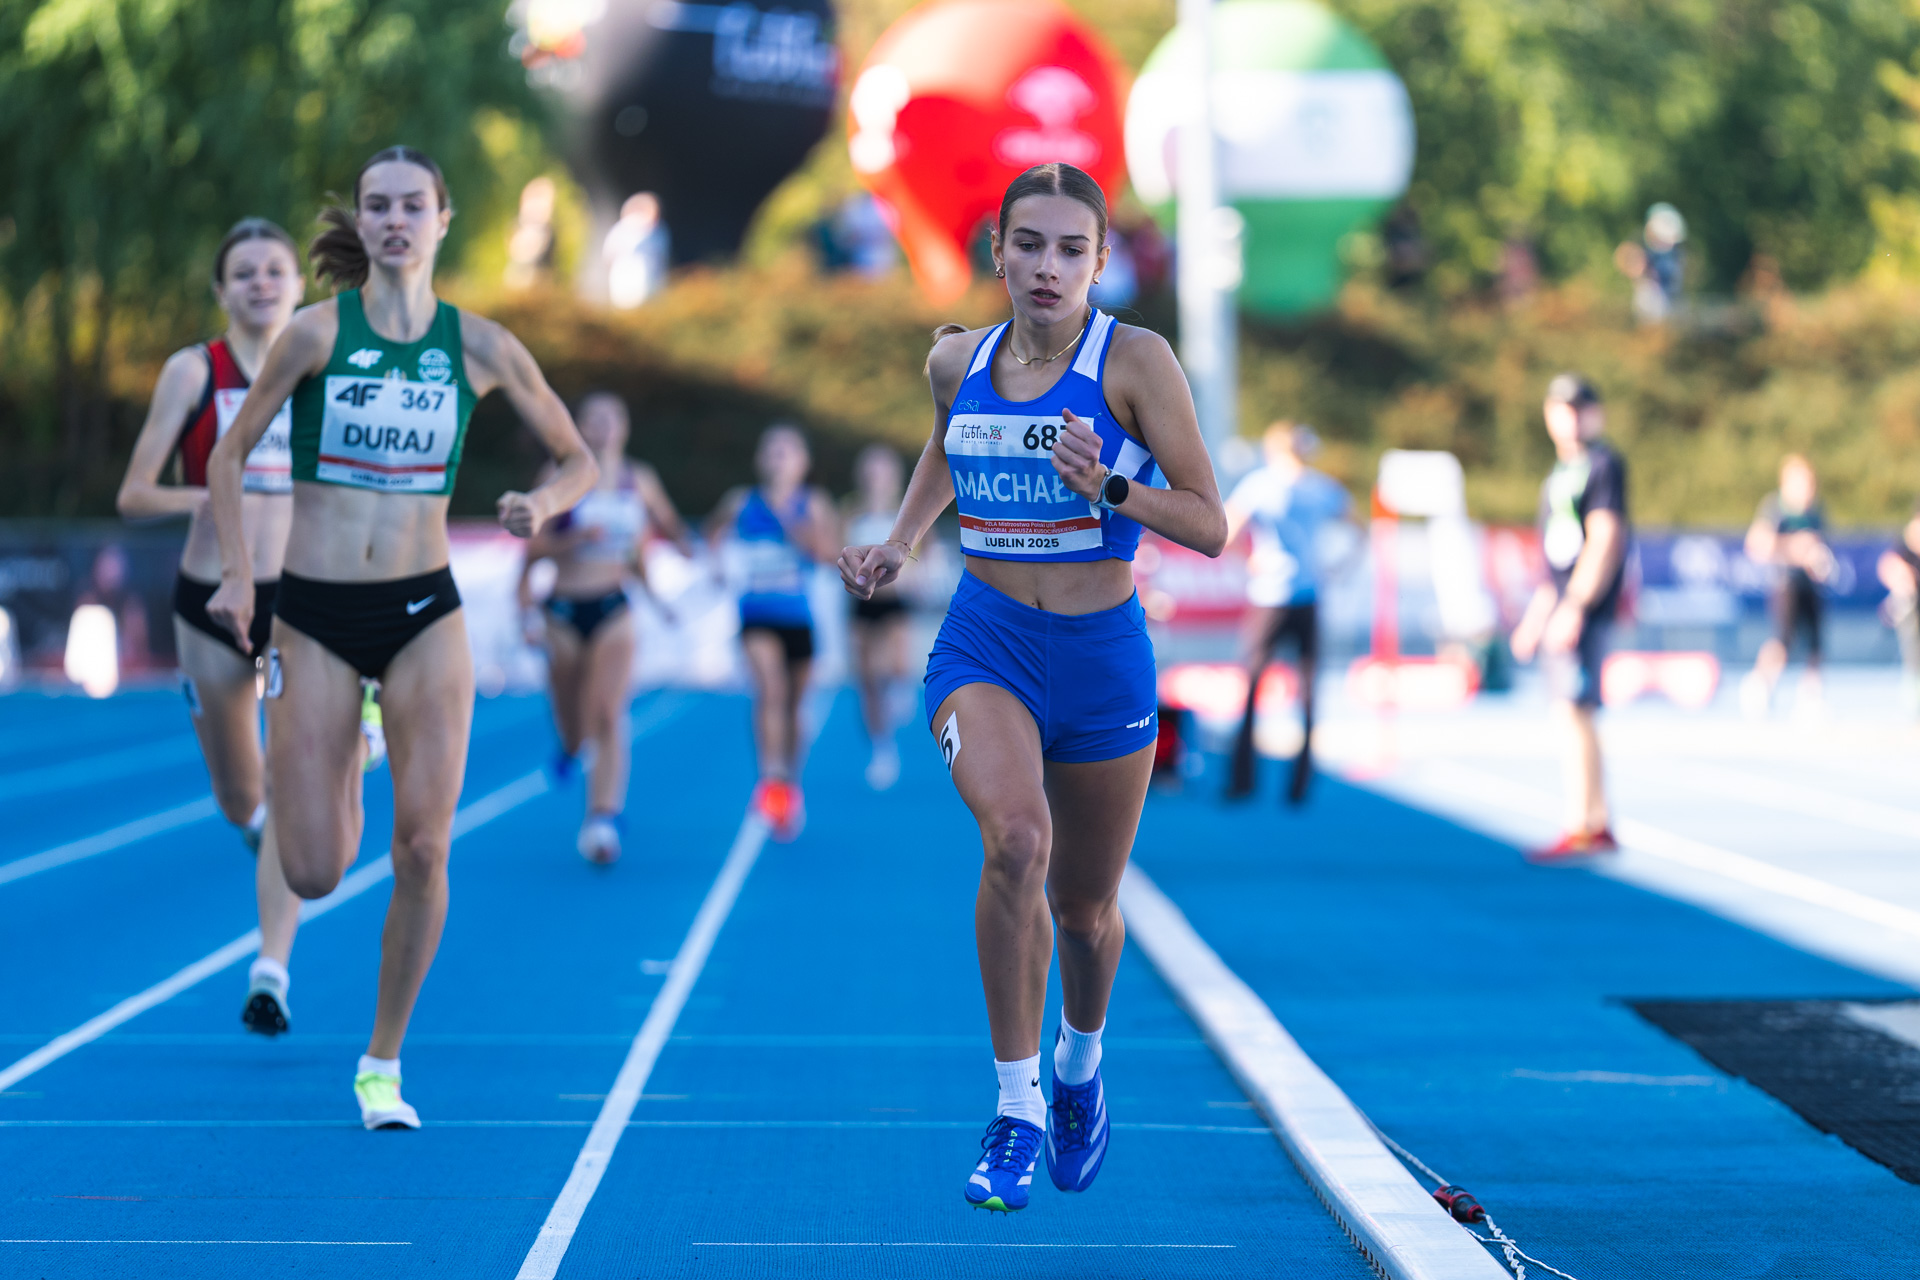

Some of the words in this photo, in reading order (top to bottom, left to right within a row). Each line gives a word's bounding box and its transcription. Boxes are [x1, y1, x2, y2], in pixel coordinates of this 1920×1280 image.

[336, 383, 384, 407] 4F
[401, 388, 445, 412] 367
[343, 423, 435, 454] DURAJ
[1022, 424, 1067, 451] 68
[954, 470, 1077, 504] MACHAŁ
[985, 537, 1025, 548] LUBLIN
[1027, 537, 1060, 548] 2025
[1034, 525, 1078, 535] KUSOCIŃSKIEGO
